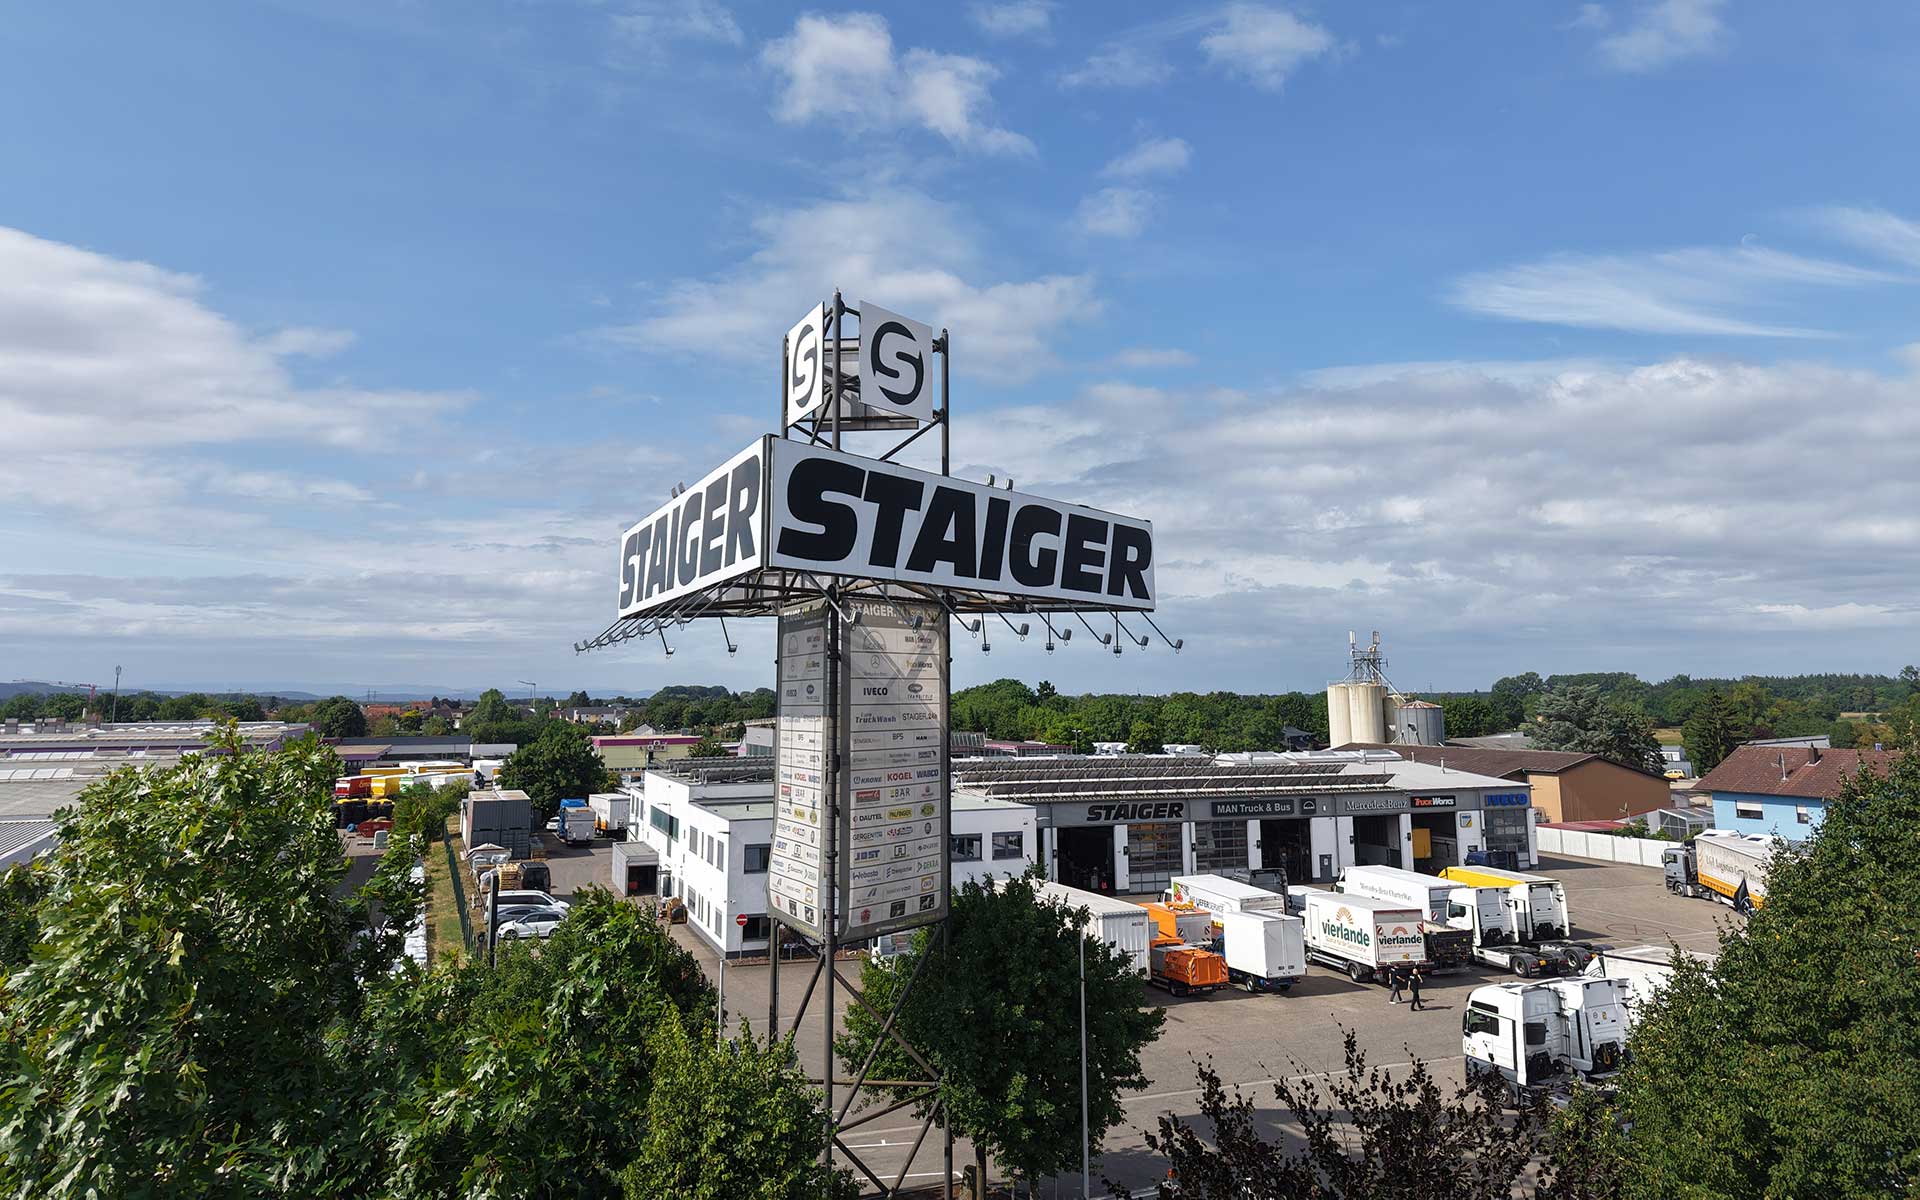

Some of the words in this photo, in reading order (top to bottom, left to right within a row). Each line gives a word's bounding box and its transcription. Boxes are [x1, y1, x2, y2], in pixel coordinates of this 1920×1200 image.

[620, 455, 760, 609] STAIGER
[777, 457, 1152, 600] STAIGER
[863, 687, 888, 696] IVECO
[916, 768, 939, 779] WABCO
[1486, 793, 1528, 807] IVECO
[1086, 802, 1184, 822] STAIGER
[1217, 804, 1238, 814] MAN
[1240, 803, 1264, 813] Truck
[1265, 803, 1272, 812] &
[1274, 802, 1291, 812] Bus
[860, 813, 882, 822] DAUTEL
[855, 849, 880, 861] JOST
[1321, 919, 1370, 947] vierlande
[1378, 935, 1422, 945] vierlande
